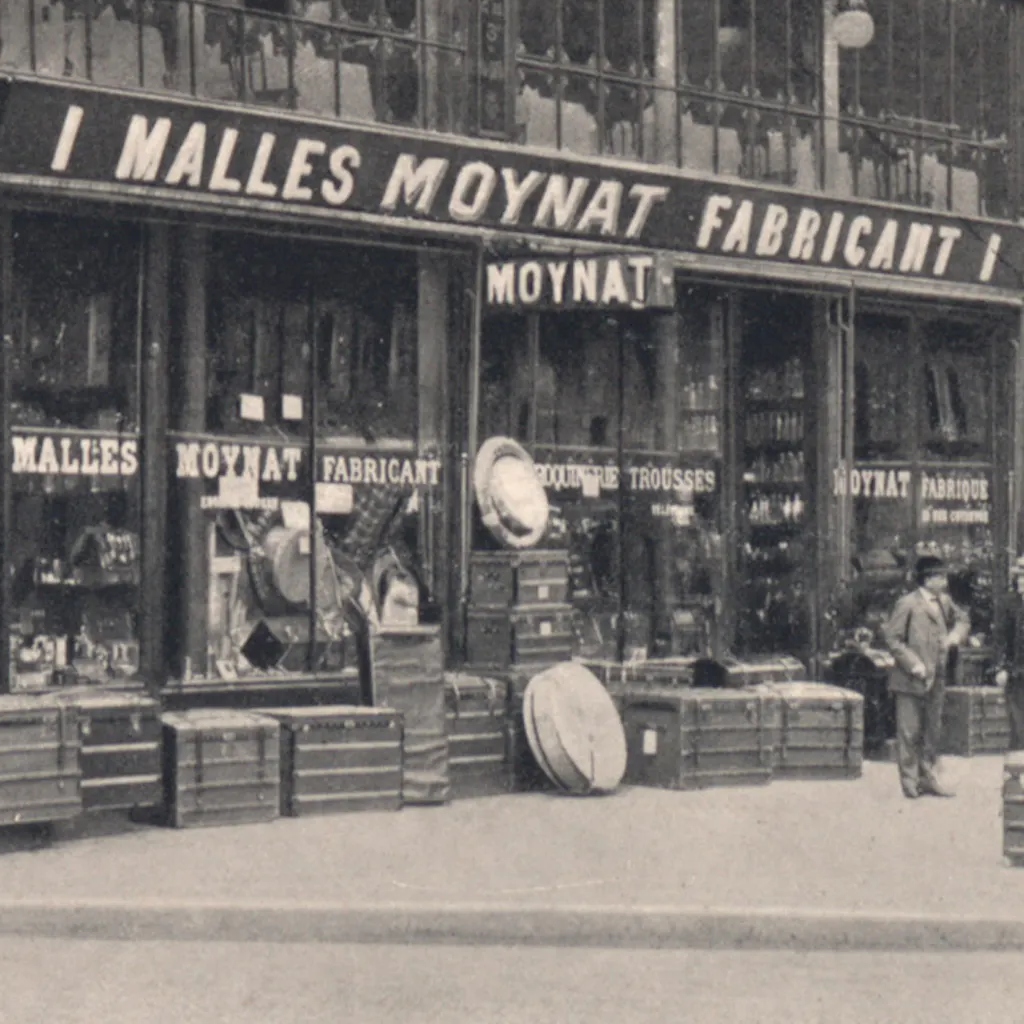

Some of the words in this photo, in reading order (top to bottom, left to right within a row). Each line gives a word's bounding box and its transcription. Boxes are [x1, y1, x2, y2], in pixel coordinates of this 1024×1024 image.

[115, 114, 361, 205] MALLES
[381, 154, 669, 238] MOYNAT
[696, 195, 961, 276] FABRICANT
[486, 257, 654, 308] MOYNAT
[11, 436, 138, 474] MALLES
[176, 442, 302, 481] MOYNAT
[323, 455, 442, 486] FABRICANT
[630, 465, 716, 493] TROUSSES
[921, 473, 989, 503] FABRIQUE
